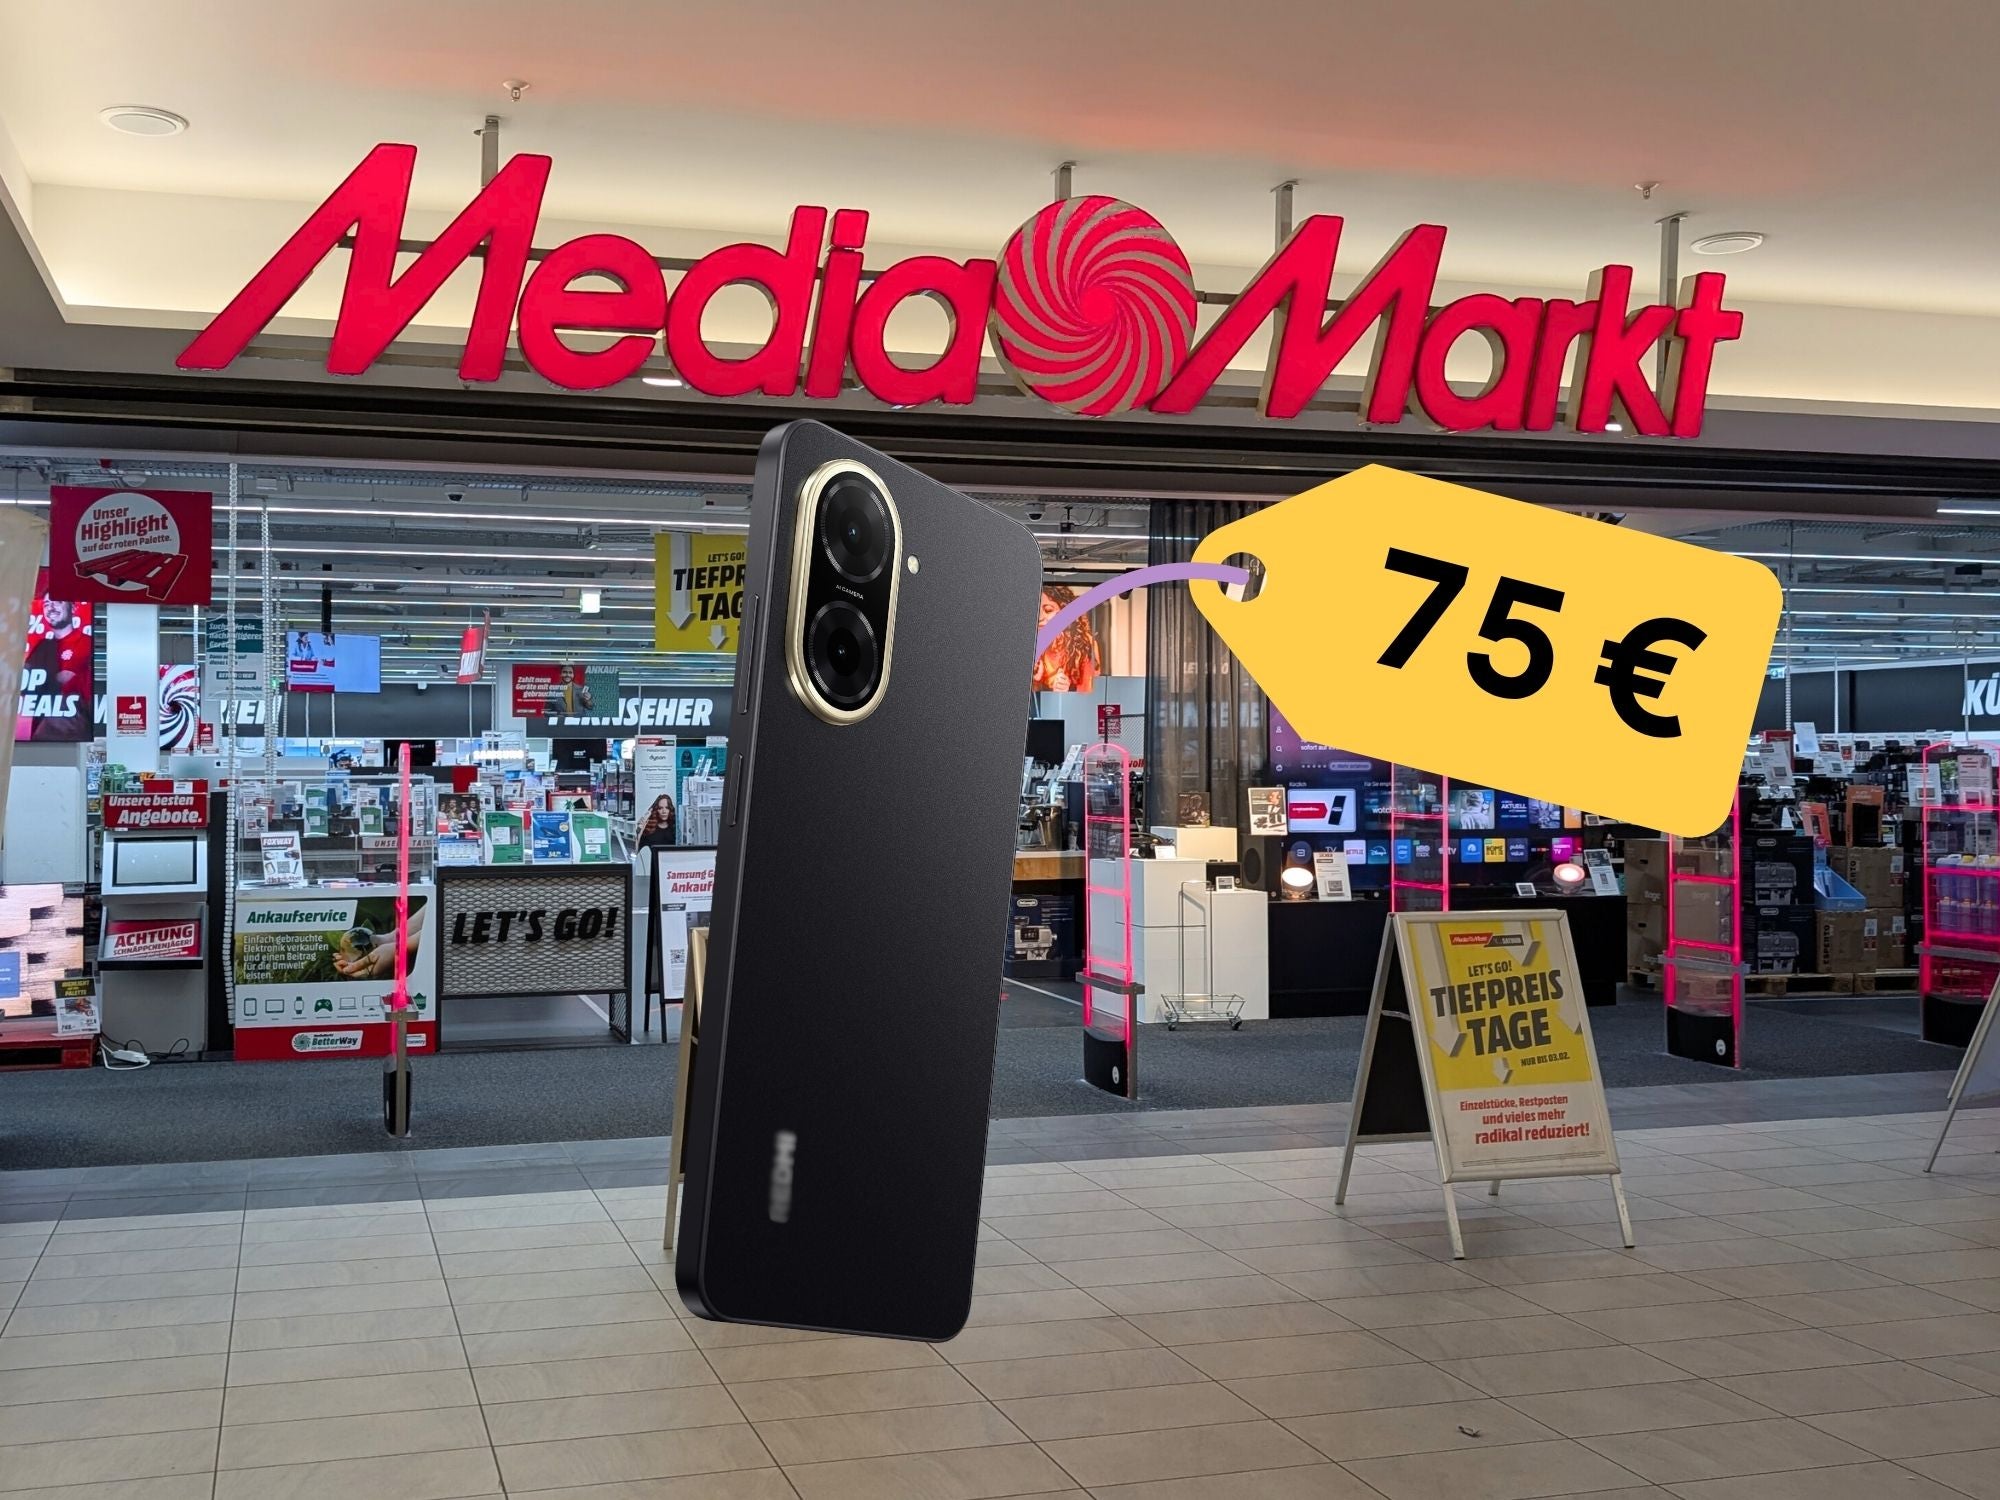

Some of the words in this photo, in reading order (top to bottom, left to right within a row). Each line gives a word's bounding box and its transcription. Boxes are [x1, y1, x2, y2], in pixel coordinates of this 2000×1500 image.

[93, 507, 129, 520] Unser
[81, 513, 168, 541] Highlight
[82, 543, 97, 552] auf
[98, 542, 113, 551] der
[114, 539, 138, 549] roten
[139, 535, 172, 545] Palette.
[708, 553, 729, 562] LET'S
[729, 552, 745, 561] GO!
[585, 666, 619, 674] ANKAUF
[109, 795, 151, 807] Unsere
[152, 795, 194, 806] besten
[117, 808, 203, 827] Angebote.
[666, 870, 707, 880] Samsung
[247, 909, 348, 924] Ankaufservice
[451, 909, 546, 945] LET'S
[553, 907, 619, 942] GO!
[114, 926, 193, 948] ACHTUNG
[243, 935, 275, 944] Einfach
[276, 934, 323, 945] gebrauchte
[113, 939, 192, 956] SCHNÄPPCHENJÄGER!
[243, 943, 286, 953] Elektronik
[286, 942, 329, 952] verkaufen
[243, 953, 260, 961] und
[261, 952, 285, 961] einen
[286, 952, 317, 963] Beitrag
[243, 962, 257, 971] für
[258, 961, 271, 970] die
[272, 960, 305, 970] Umwelt
[1467, 961, 1494, 978] LET'S
[1494, 960, 1512, 974] GO!
[243, 970, 274, 979] leisten.
[1430, 969, 1564, 1018] TIEFPREIS
[1466, 1008, 1552, 1056] TAGE
[312, 1036, 358, 1047] BetterWay
[1520, 1057, 1536, 1067] NUR
[1537, 1055, 1548, 1065] BIS
[1459, 1096, 1518, 1112] Einzelstücke,
[1518, 1094, 1568, 1109] Restposten
[1482, 1112, 1504, 1125] und
[1505, 1110, 1536, 1123] vieles
[1537, 1109, 1566, 1122] mehr
[1475, 1127, 1523, 1145] radikal
[1525, 1122, 1590, 1142] reduziert!
